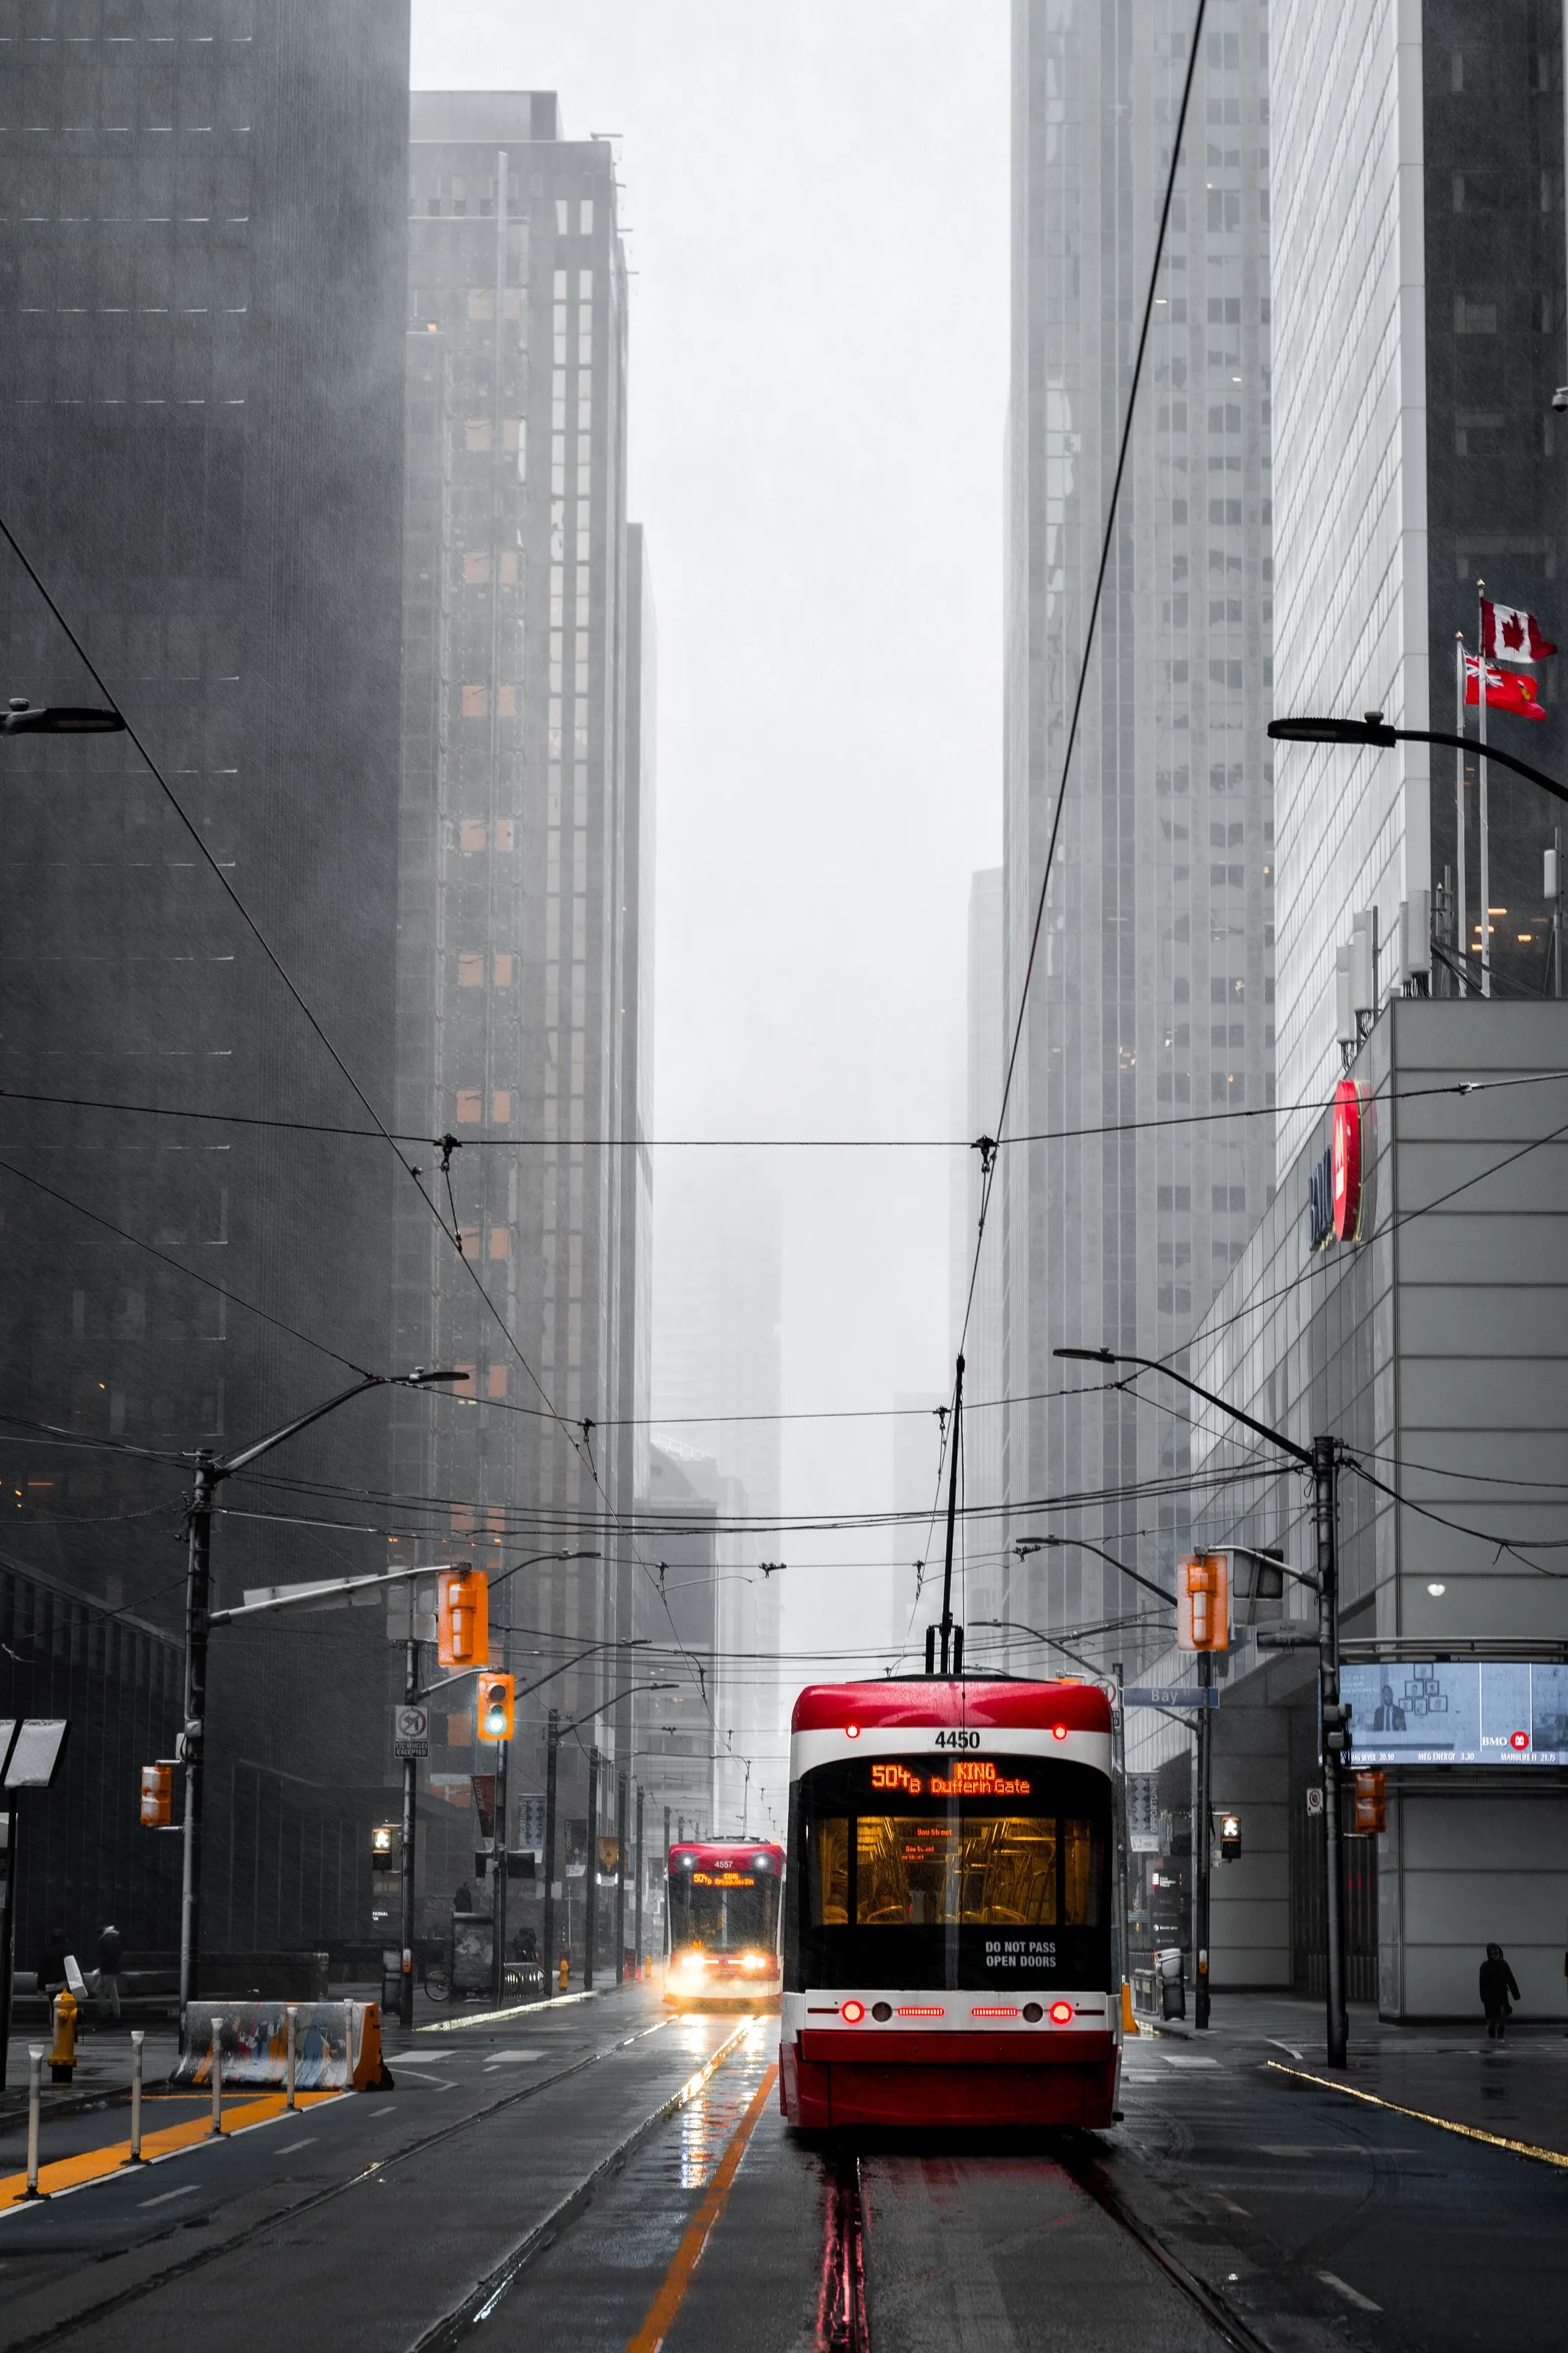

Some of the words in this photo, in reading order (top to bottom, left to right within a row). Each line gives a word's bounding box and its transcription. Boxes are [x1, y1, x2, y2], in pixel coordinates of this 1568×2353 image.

[1151, 1689, 1178, 1705] Bay
[935, 1731, 980, 1749] 4450
[1482, 1737, 1507, 1746] BMO
[1418, 1753, 1431, 1761] MEG
[1433, 1753, 1456, 1761] ENERGY
[1500, 1753, 1530, 1762] MANULIFE
[956, 1762, 995, 1779] KING
[931, 1778, 991, 1793] Dufferin
[995, 1778, 1030, 1793] Gate
[985, 1941, 1001, 1952] DO
[1004, 1941, 1026, 1952] NOT
[1029, 1941, 1056, 1953] PASS
[986, 1956, 1017, 1967] OPEN
[1020, 1956, 1056, 1968] DOORS
